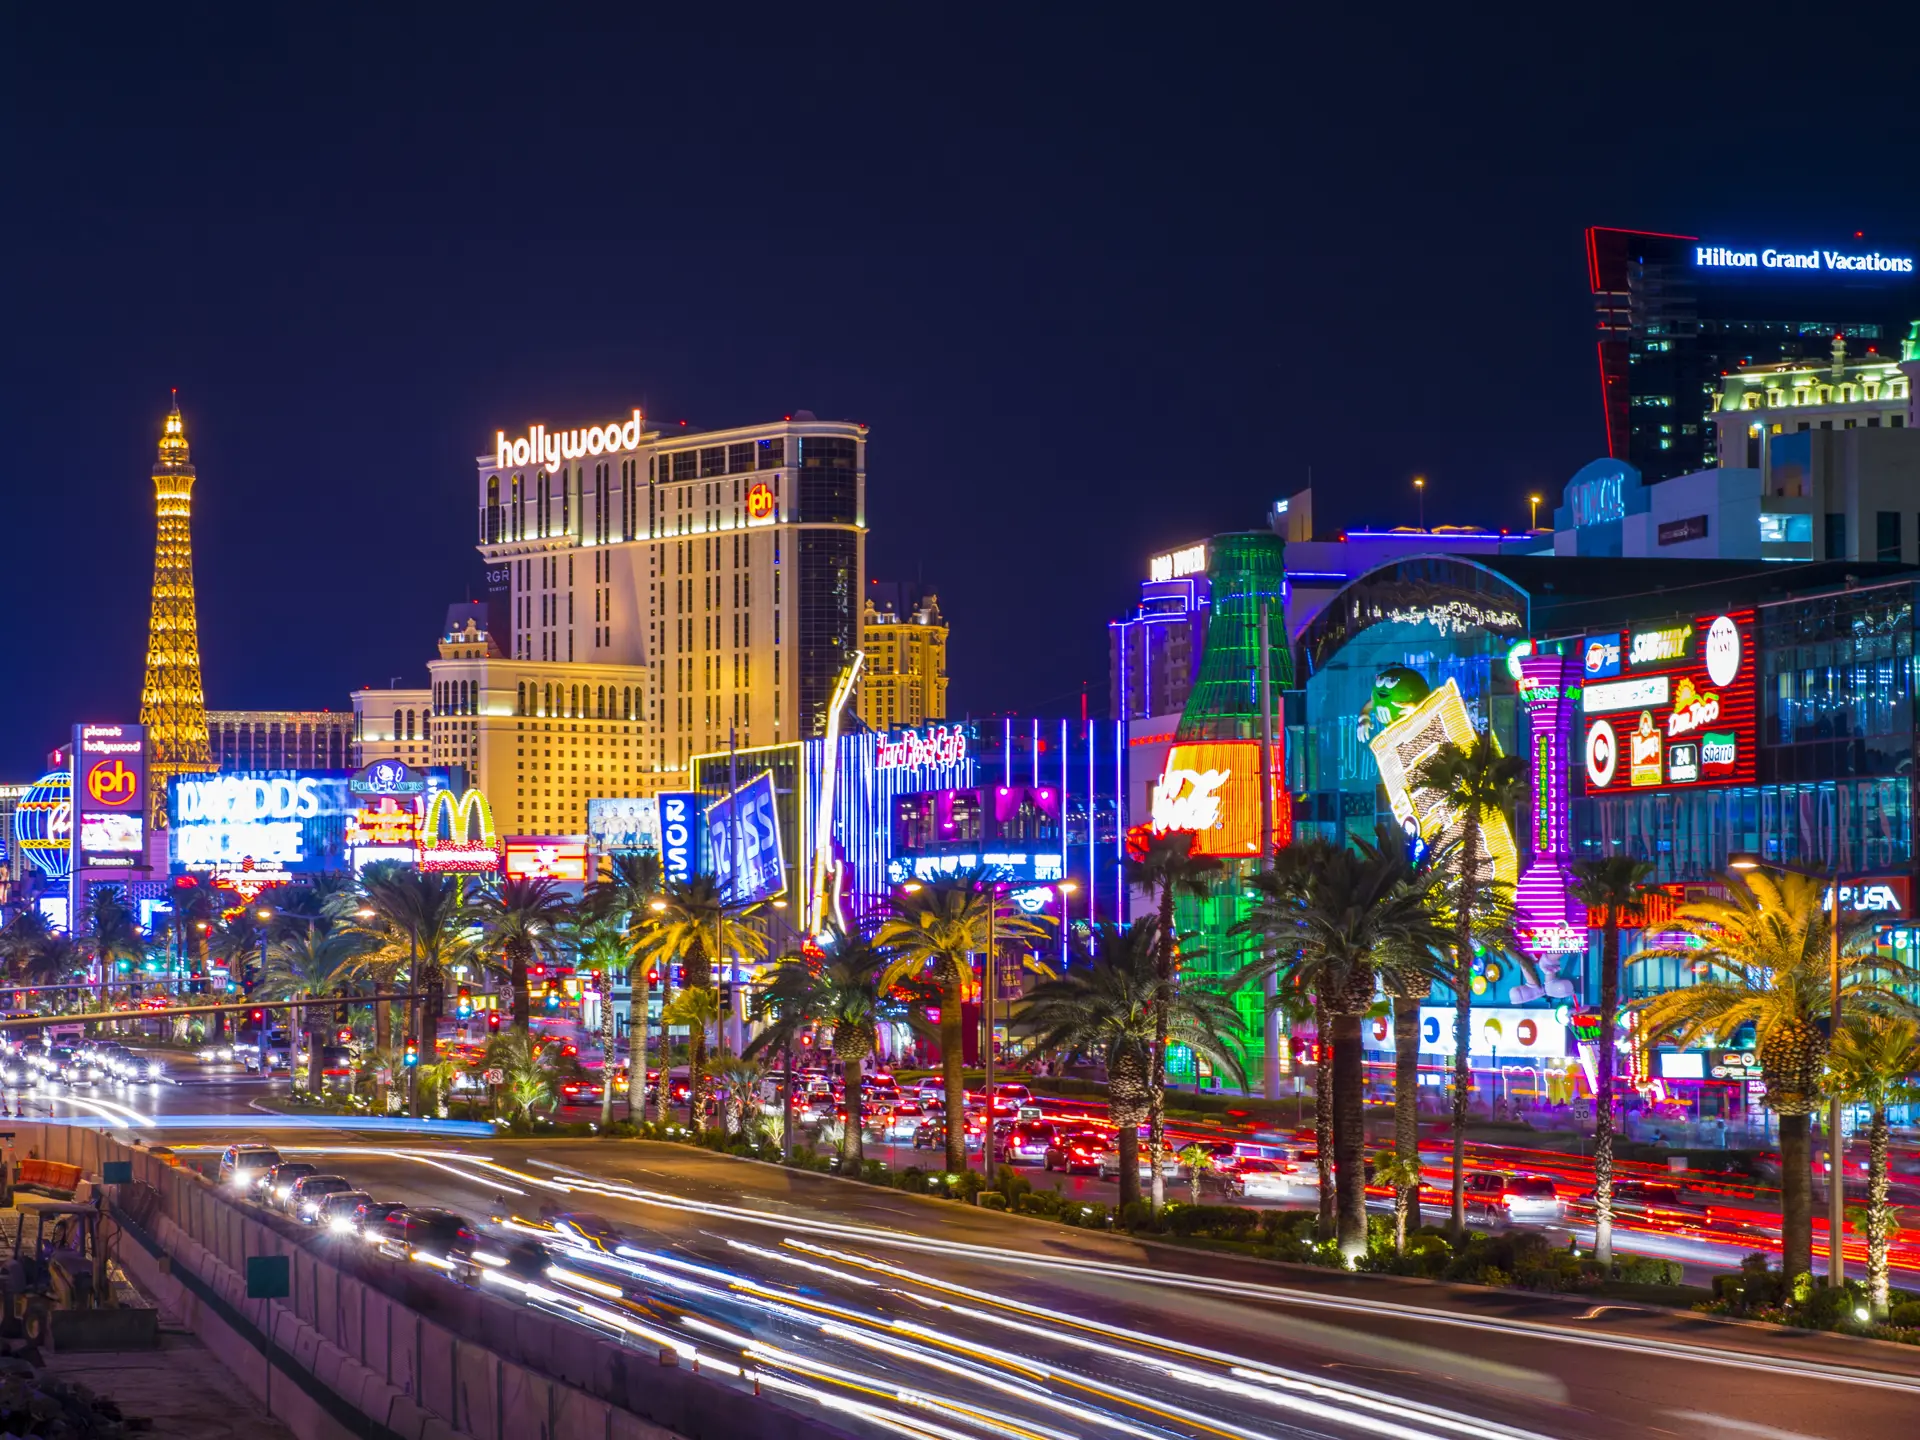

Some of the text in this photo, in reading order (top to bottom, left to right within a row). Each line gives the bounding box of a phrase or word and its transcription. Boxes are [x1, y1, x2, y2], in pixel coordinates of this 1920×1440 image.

[1696, 248, 1912, 272] Hilton Grand Vacations
[497, 409, 640, 473] hollywood
[1629, 625, 1692, 665] SUBWAY
[84, 725, 122, 739] planet
[84, 740, 141, 755] hollywood
[1703, 740, 1733, 763] sbarro
[350, 780, 380, 791] POLO
[1600, 783, 1893, 877] WESTGATE RESORTS
[1575, 1110, 1589, 1119] 30
